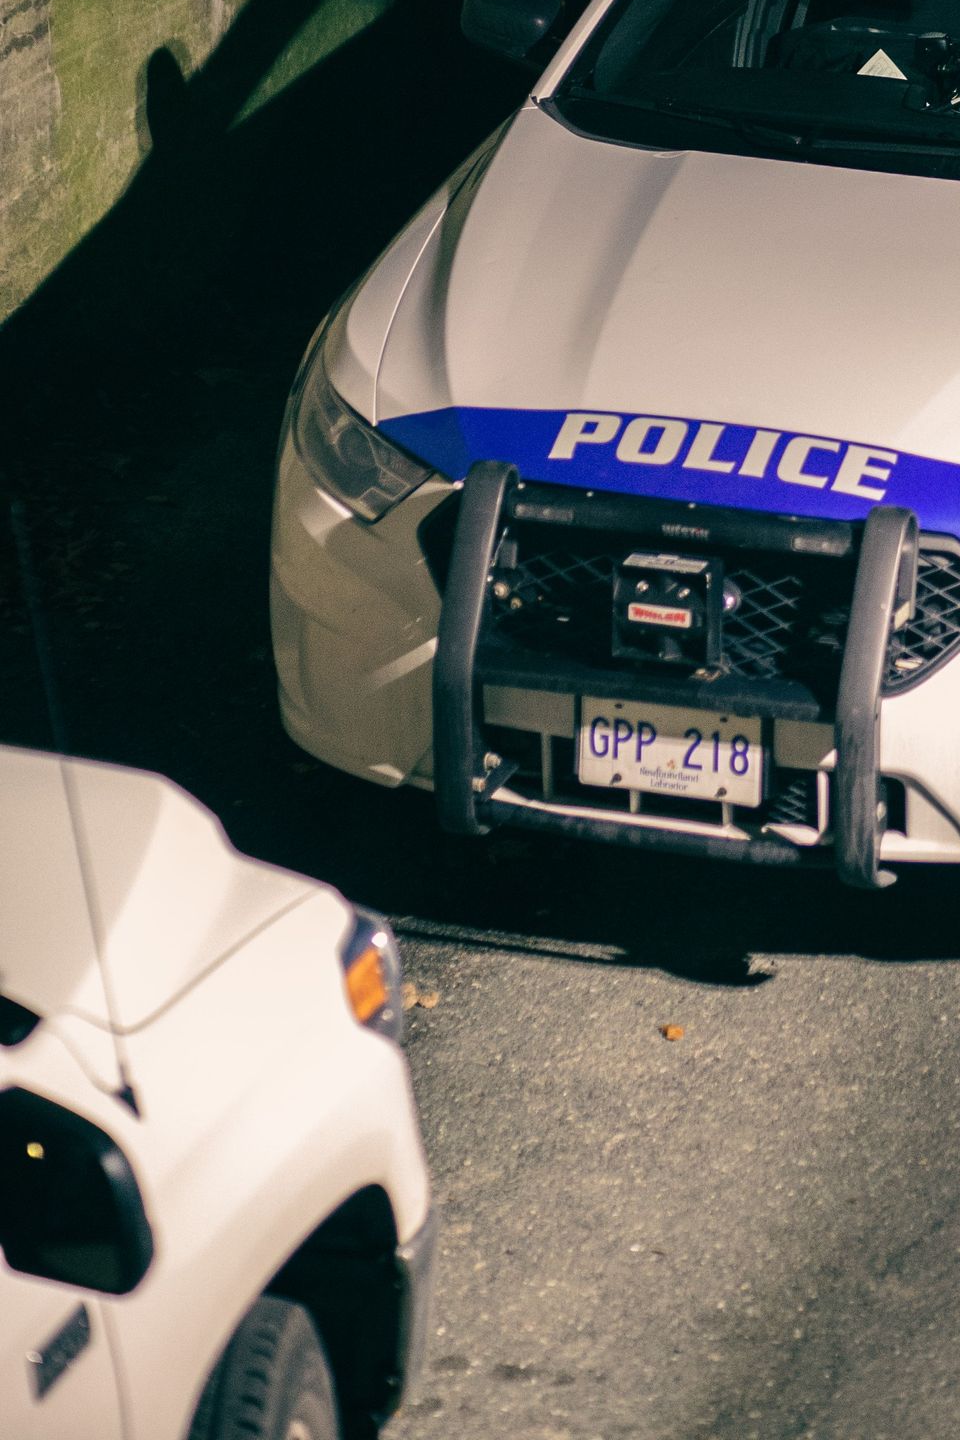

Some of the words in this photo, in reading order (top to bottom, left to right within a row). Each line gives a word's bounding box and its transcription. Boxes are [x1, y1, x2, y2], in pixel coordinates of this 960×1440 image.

[548, 413, 898, 501] POLICE
[590, 716, 657, 763] GPP
[682, 727, 750, 776] 218
[640, 766, 699, 783] Newfoundland
